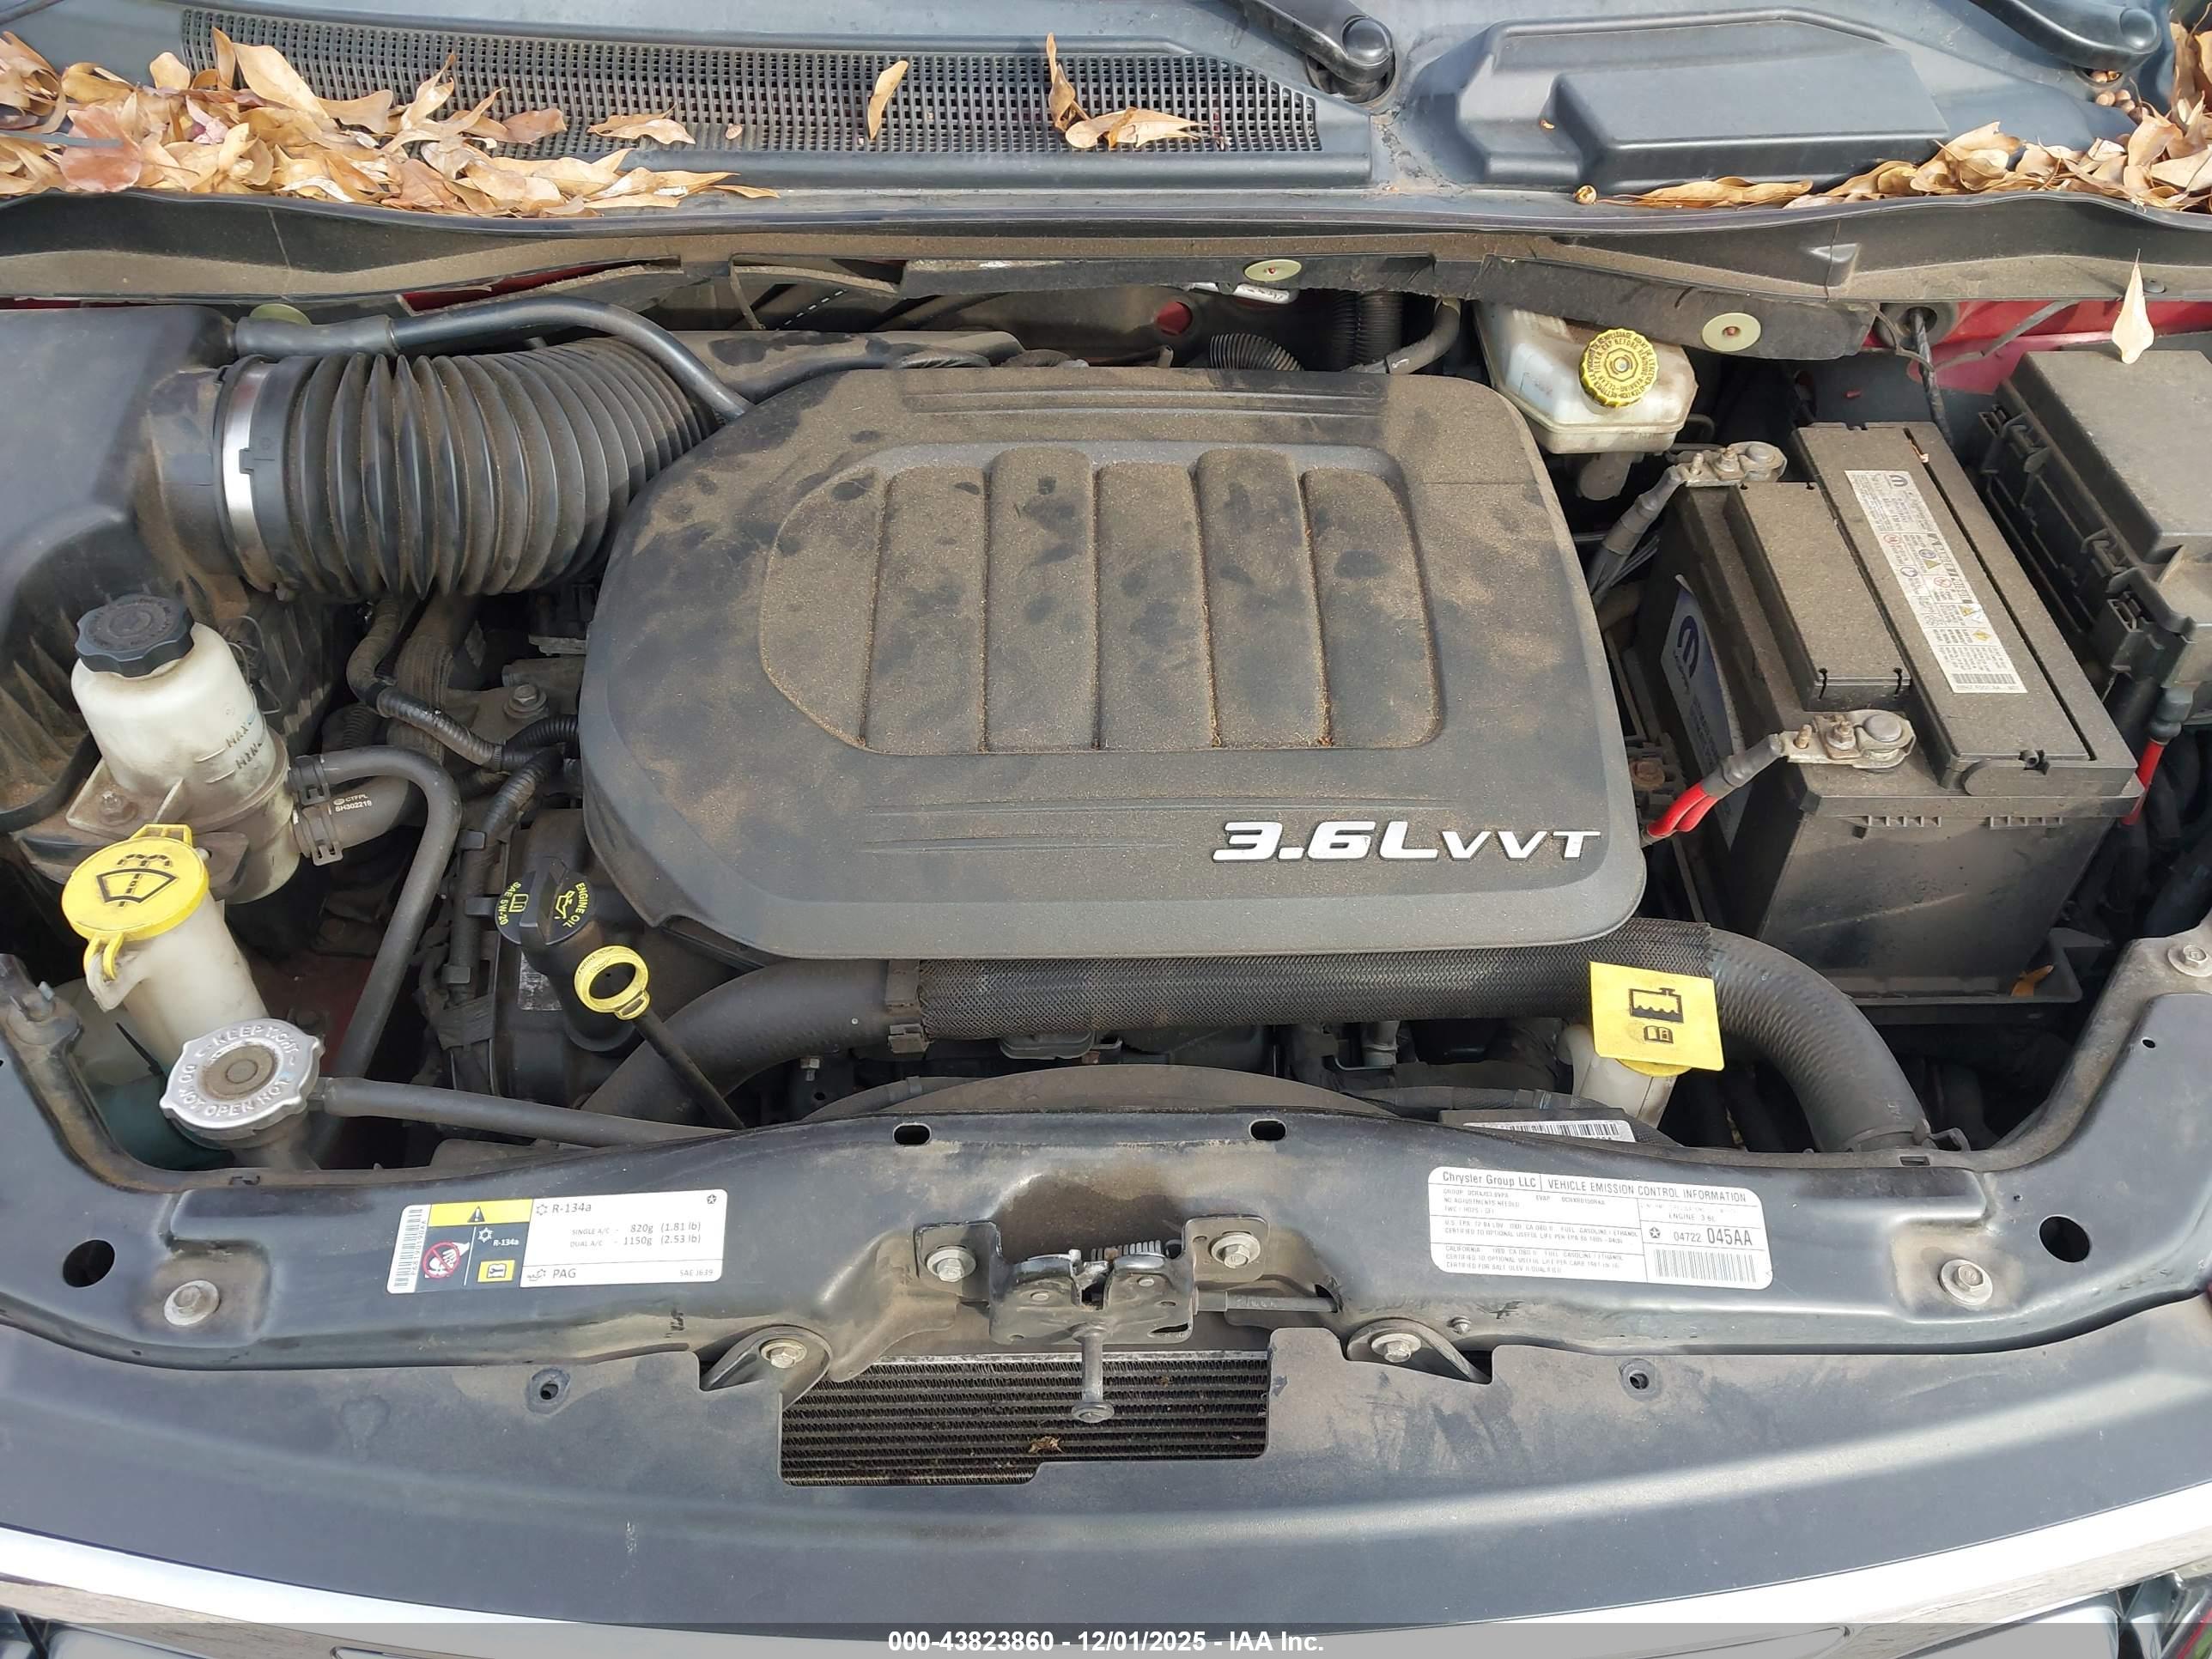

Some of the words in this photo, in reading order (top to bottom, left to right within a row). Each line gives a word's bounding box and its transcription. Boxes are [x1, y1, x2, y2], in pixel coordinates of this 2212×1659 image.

[1601, 340, 1613, 350] CAP
[1614, 338, 1638, 349] BEFORE
[1212, 821, 1438, 861] 3.6L
[1441, 830, 1601, 860] VVT
[505, 882, 521, 897] SAE
[574, 882, 589, 915] ENGINE
[498, 898, 509, 926] 5W-20
[562, 915, 580, 928] OIL
[212, 1025, 264, 1046] KEEP
[204, 1099, 255, 1117] OPEN
[1443, 1170, 1482, 1185] Chrysler
[1486, 1174, 1515, 1188] Group
[1518, 1176, 1536, 1188] LLC
[1548, 1179, 1587, 1191] VEHICLE
[1590, 1182, 1635, 1194] EMISSION
[1638, 1186, 1680, 1198] CONTROL
[1683, 1189, 1747, 1202] INFORMATION
[551, 1202, 592, 1213] R-134a
[597, 1226, 611, 1235] A/C
[630, 1223, 653, 1234] 820g
[660, 1222, 684, 1232] (1.81
[688, 1221, 702, 1231] lb)
[492, 1238, 520, 1247] R-134a
[569, 1240, 588, 1249] DUAL
[590, 1239, 603, 1248] A/C
[623, 1236, 653, 1246] 1150g
[660, 1234, 684, 1244] (2.53
[688, 1234, 702, 1244] lb)
[1673, 1231, 1702, 1243] 04722
[1706, 1228, 1753, 1246] 045AA
[552, 1267, 577, 1279] PAG
[679, 1268, 693, 1277] SAE
[696, 1267, 714, 1277] J639
